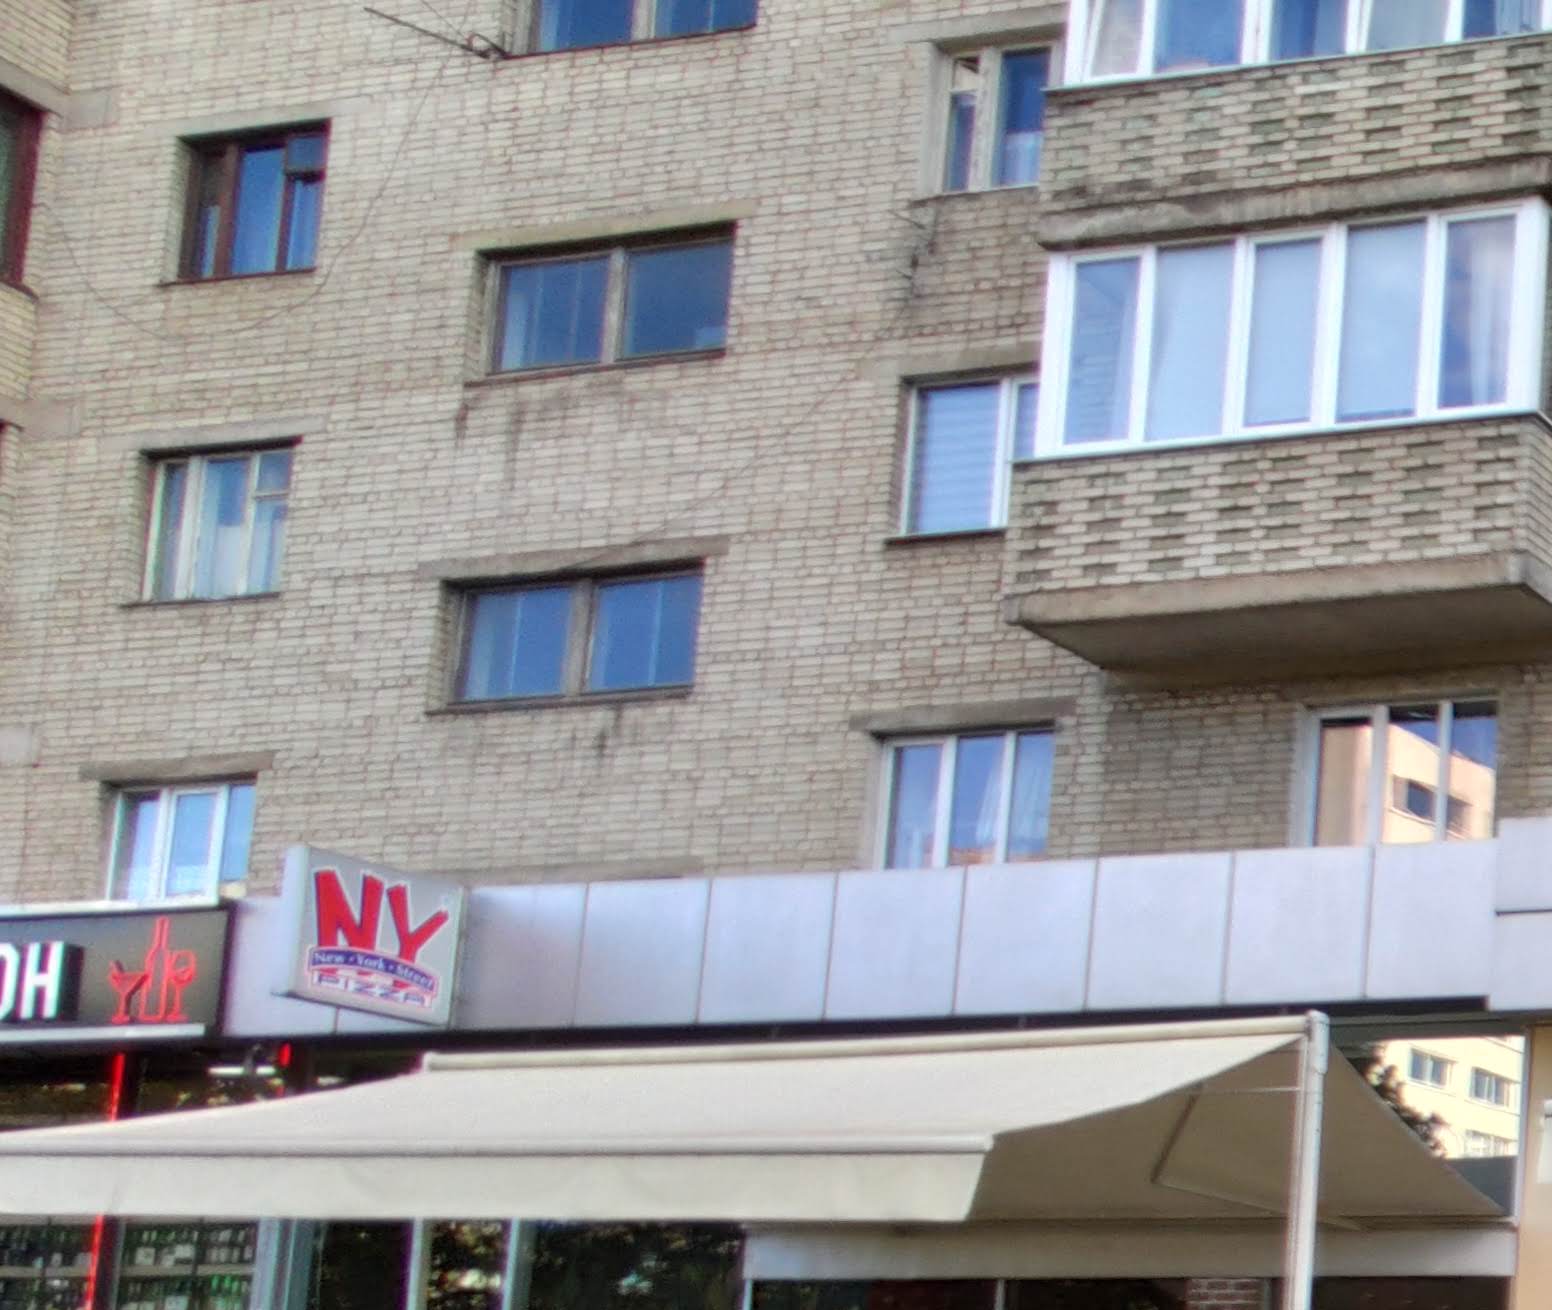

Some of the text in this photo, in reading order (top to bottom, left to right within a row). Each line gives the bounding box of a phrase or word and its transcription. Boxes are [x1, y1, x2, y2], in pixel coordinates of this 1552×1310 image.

[313, 868, 450, 964] NY
[314, 951, 345, 964] New
[356, 954, 386, 970] York
